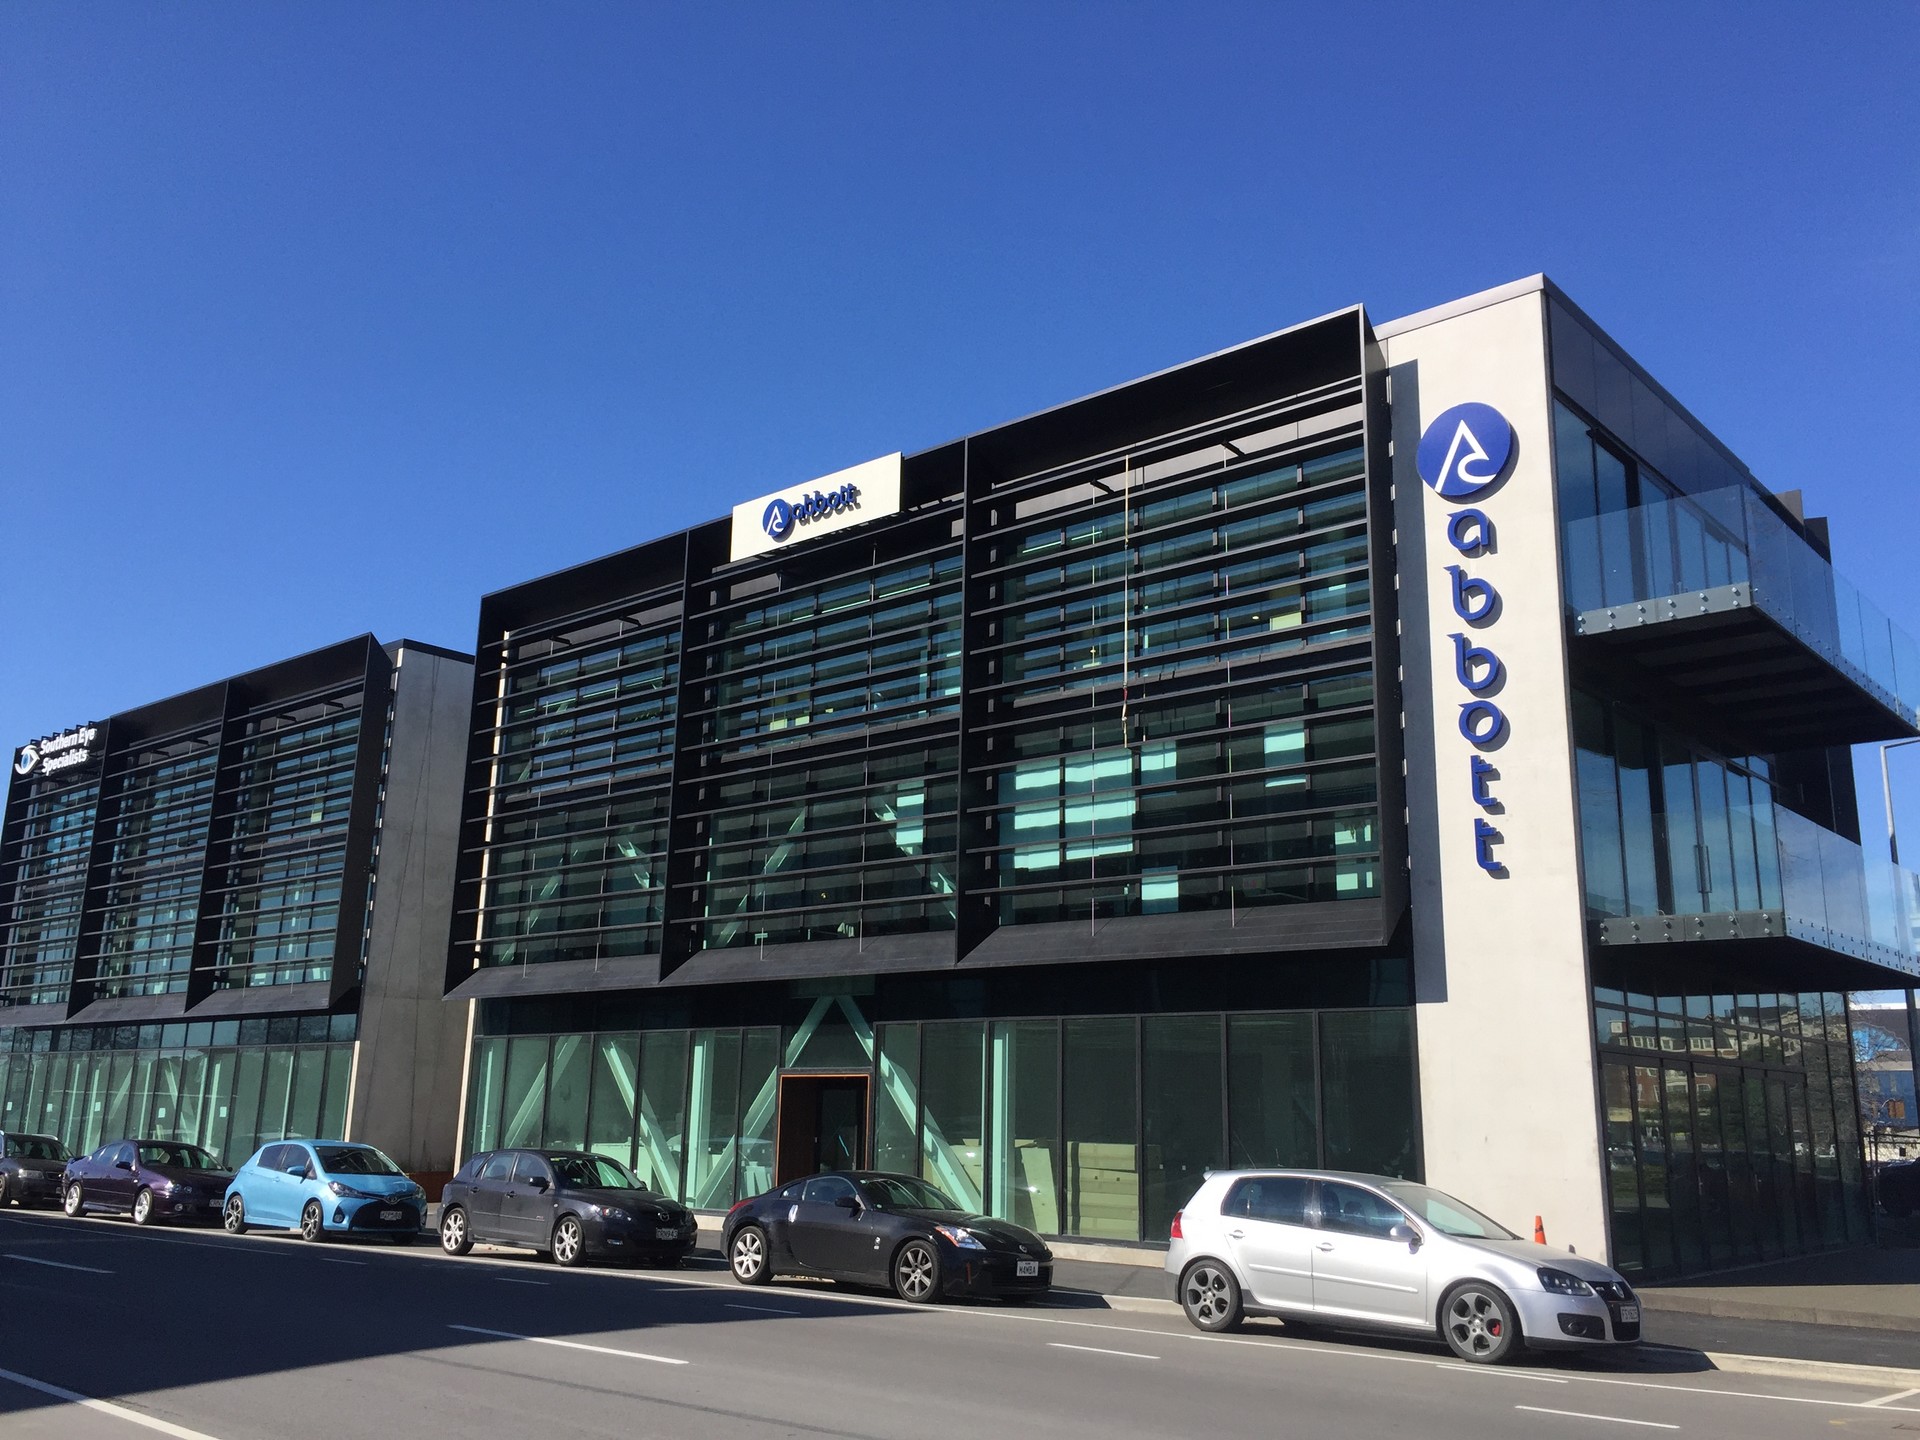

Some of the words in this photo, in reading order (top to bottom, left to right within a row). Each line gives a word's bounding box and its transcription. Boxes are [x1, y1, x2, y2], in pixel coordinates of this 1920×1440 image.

[791, 483, 857, 520] abbott
[1444, 508, 1502, 874] abbott
[39, 732, 78, 755] Southern
[78, 727, 97, 746] Eye
[41, 748, 90, 776] Specialists
